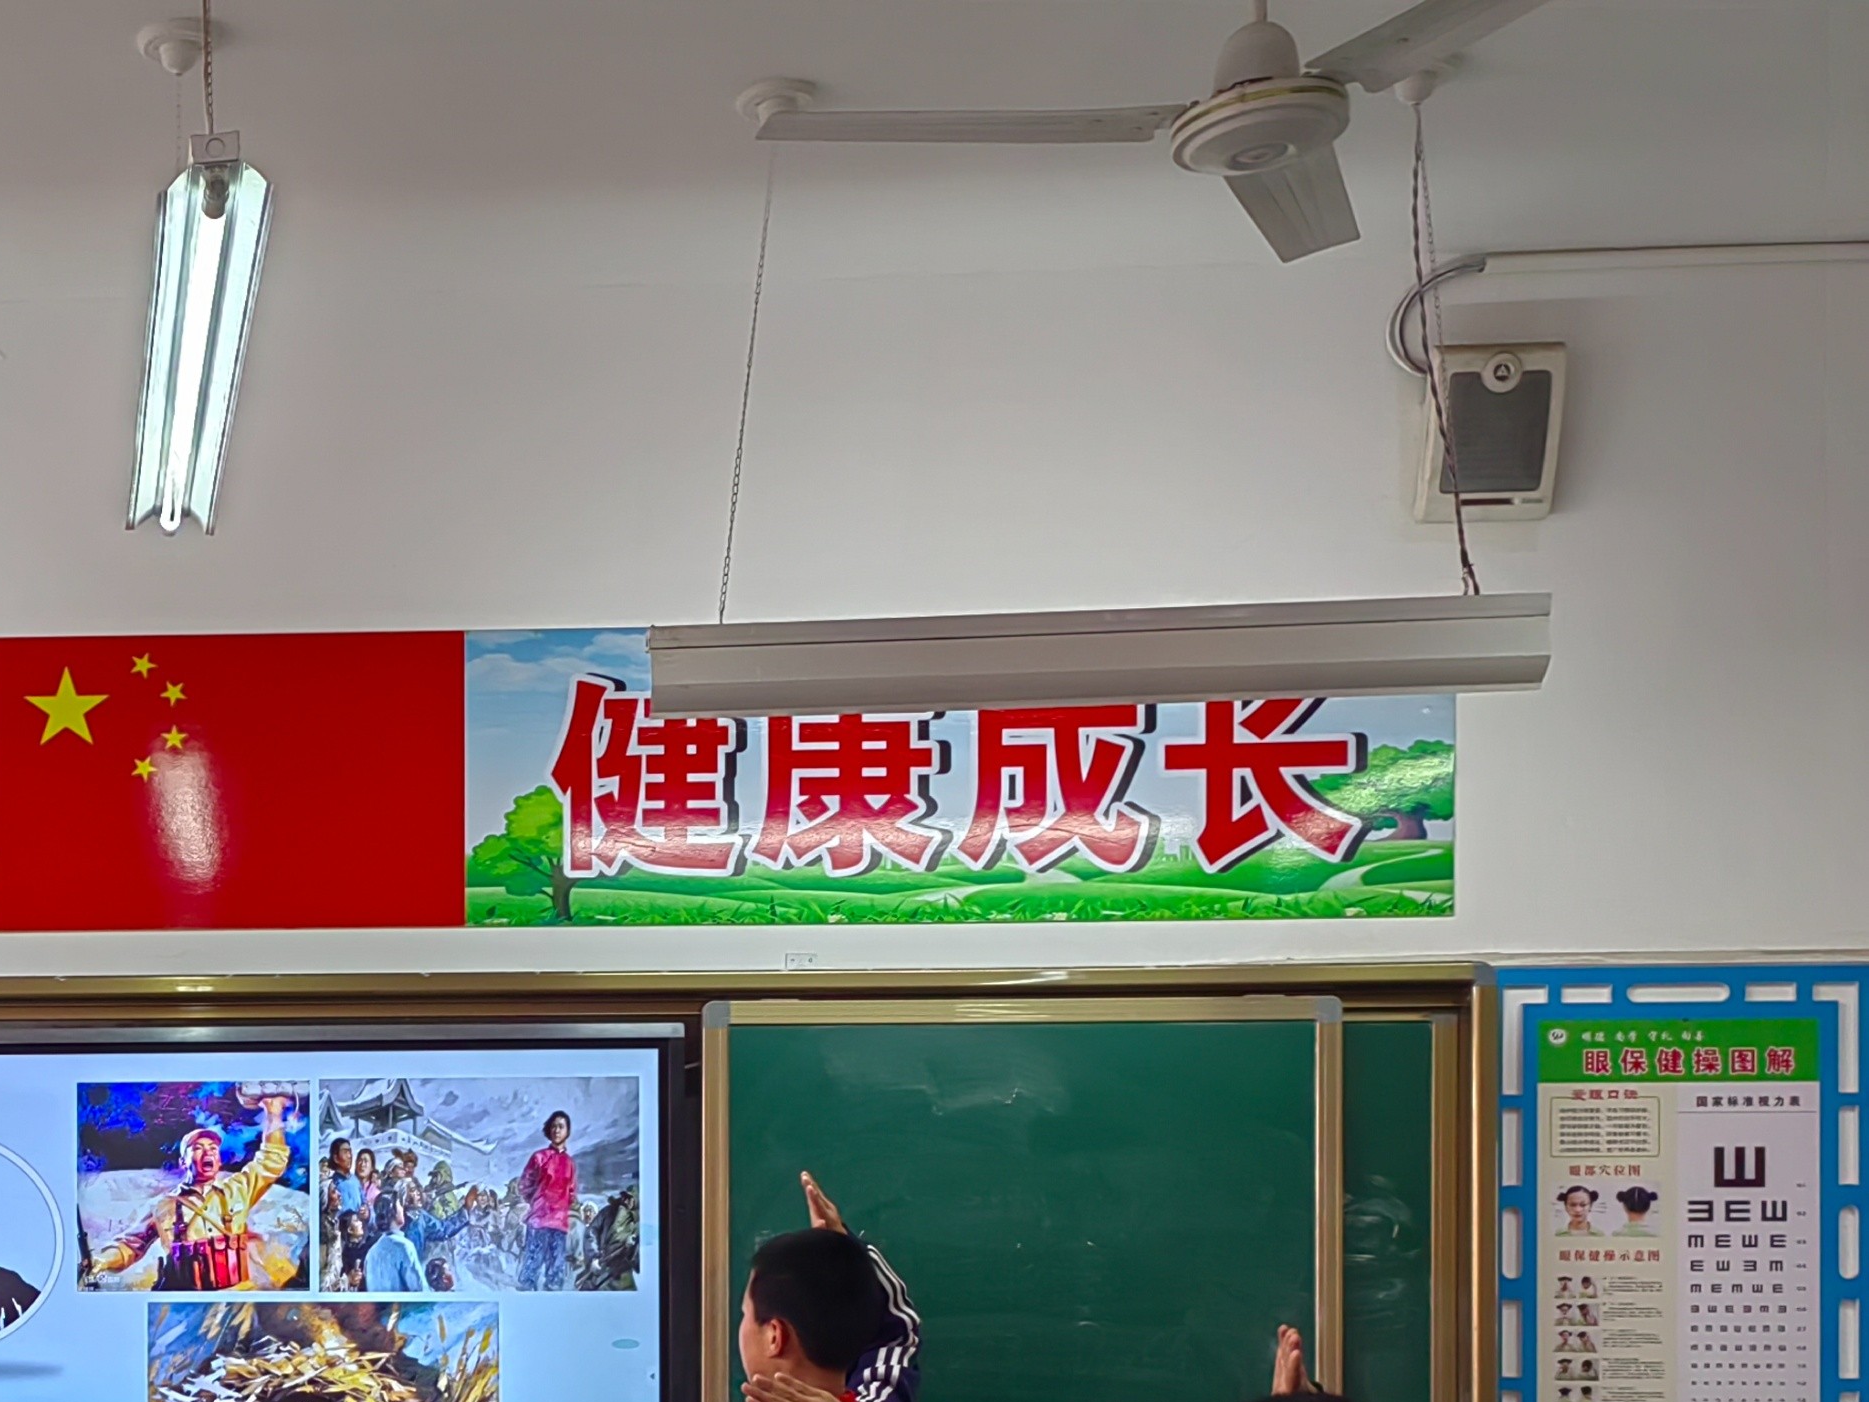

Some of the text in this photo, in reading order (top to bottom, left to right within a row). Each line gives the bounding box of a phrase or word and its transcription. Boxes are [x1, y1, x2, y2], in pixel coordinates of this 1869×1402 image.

[550, 673, 1368, 878] 健康成长
[1583, 1047, 1795, 1075] 眼保健操图解
[1696, 1096, 1802, 1108] 国家标准视力表
